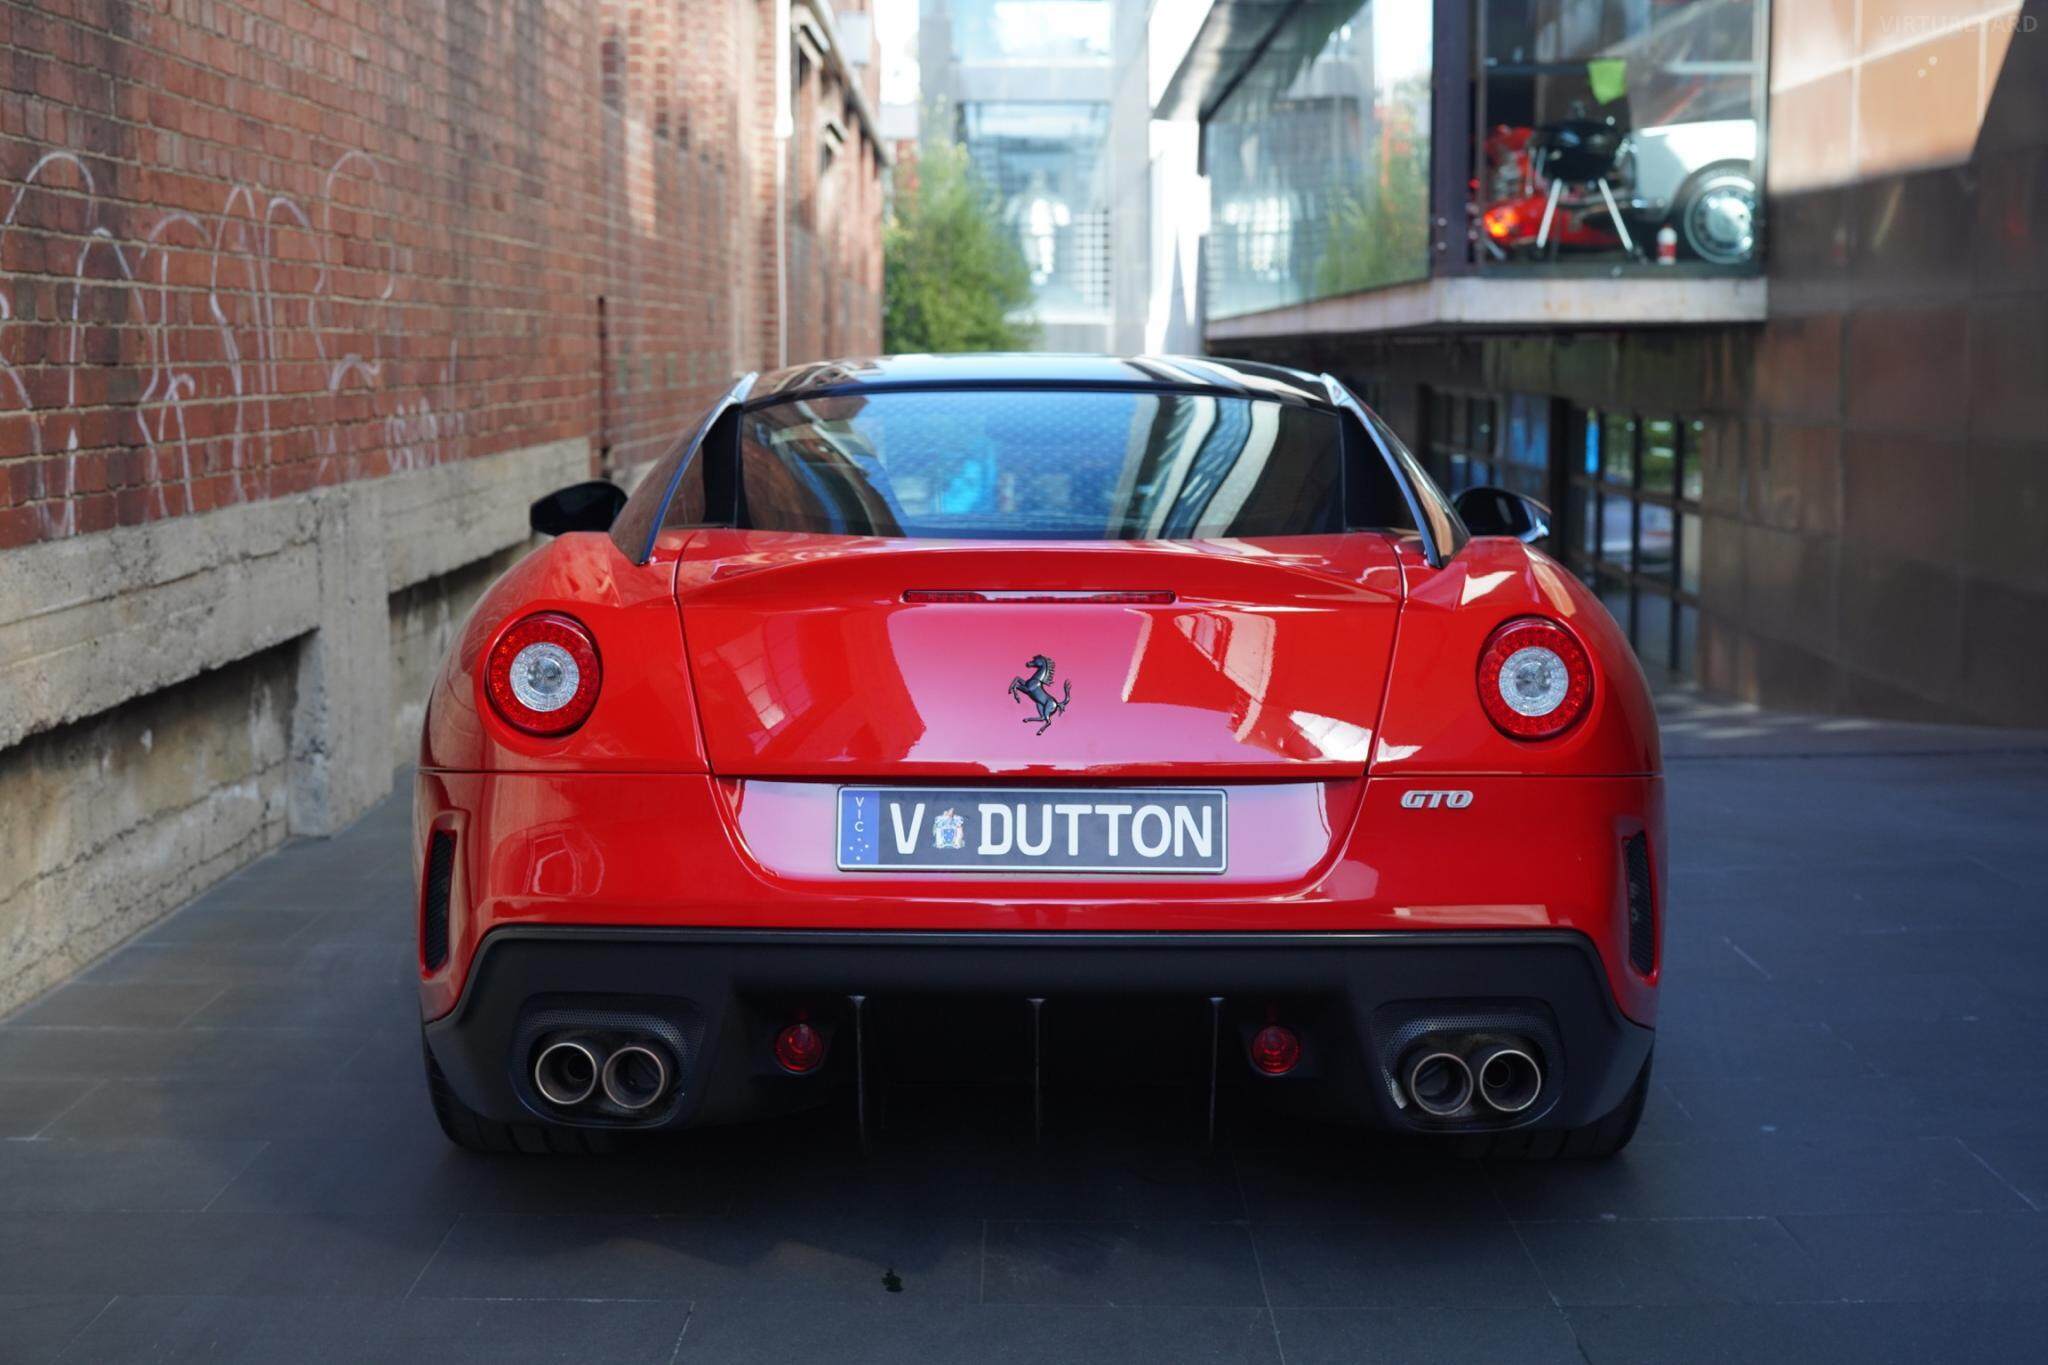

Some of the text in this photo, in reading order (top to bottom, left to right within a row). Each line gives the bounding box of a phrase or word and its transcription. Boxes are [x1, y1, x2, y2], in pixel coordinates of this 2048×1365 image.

[854, 796, 865, 832] VIC
[1400, 789, 1474, 809] GTO
[889, 802, 1213, 858] V DUTTON
